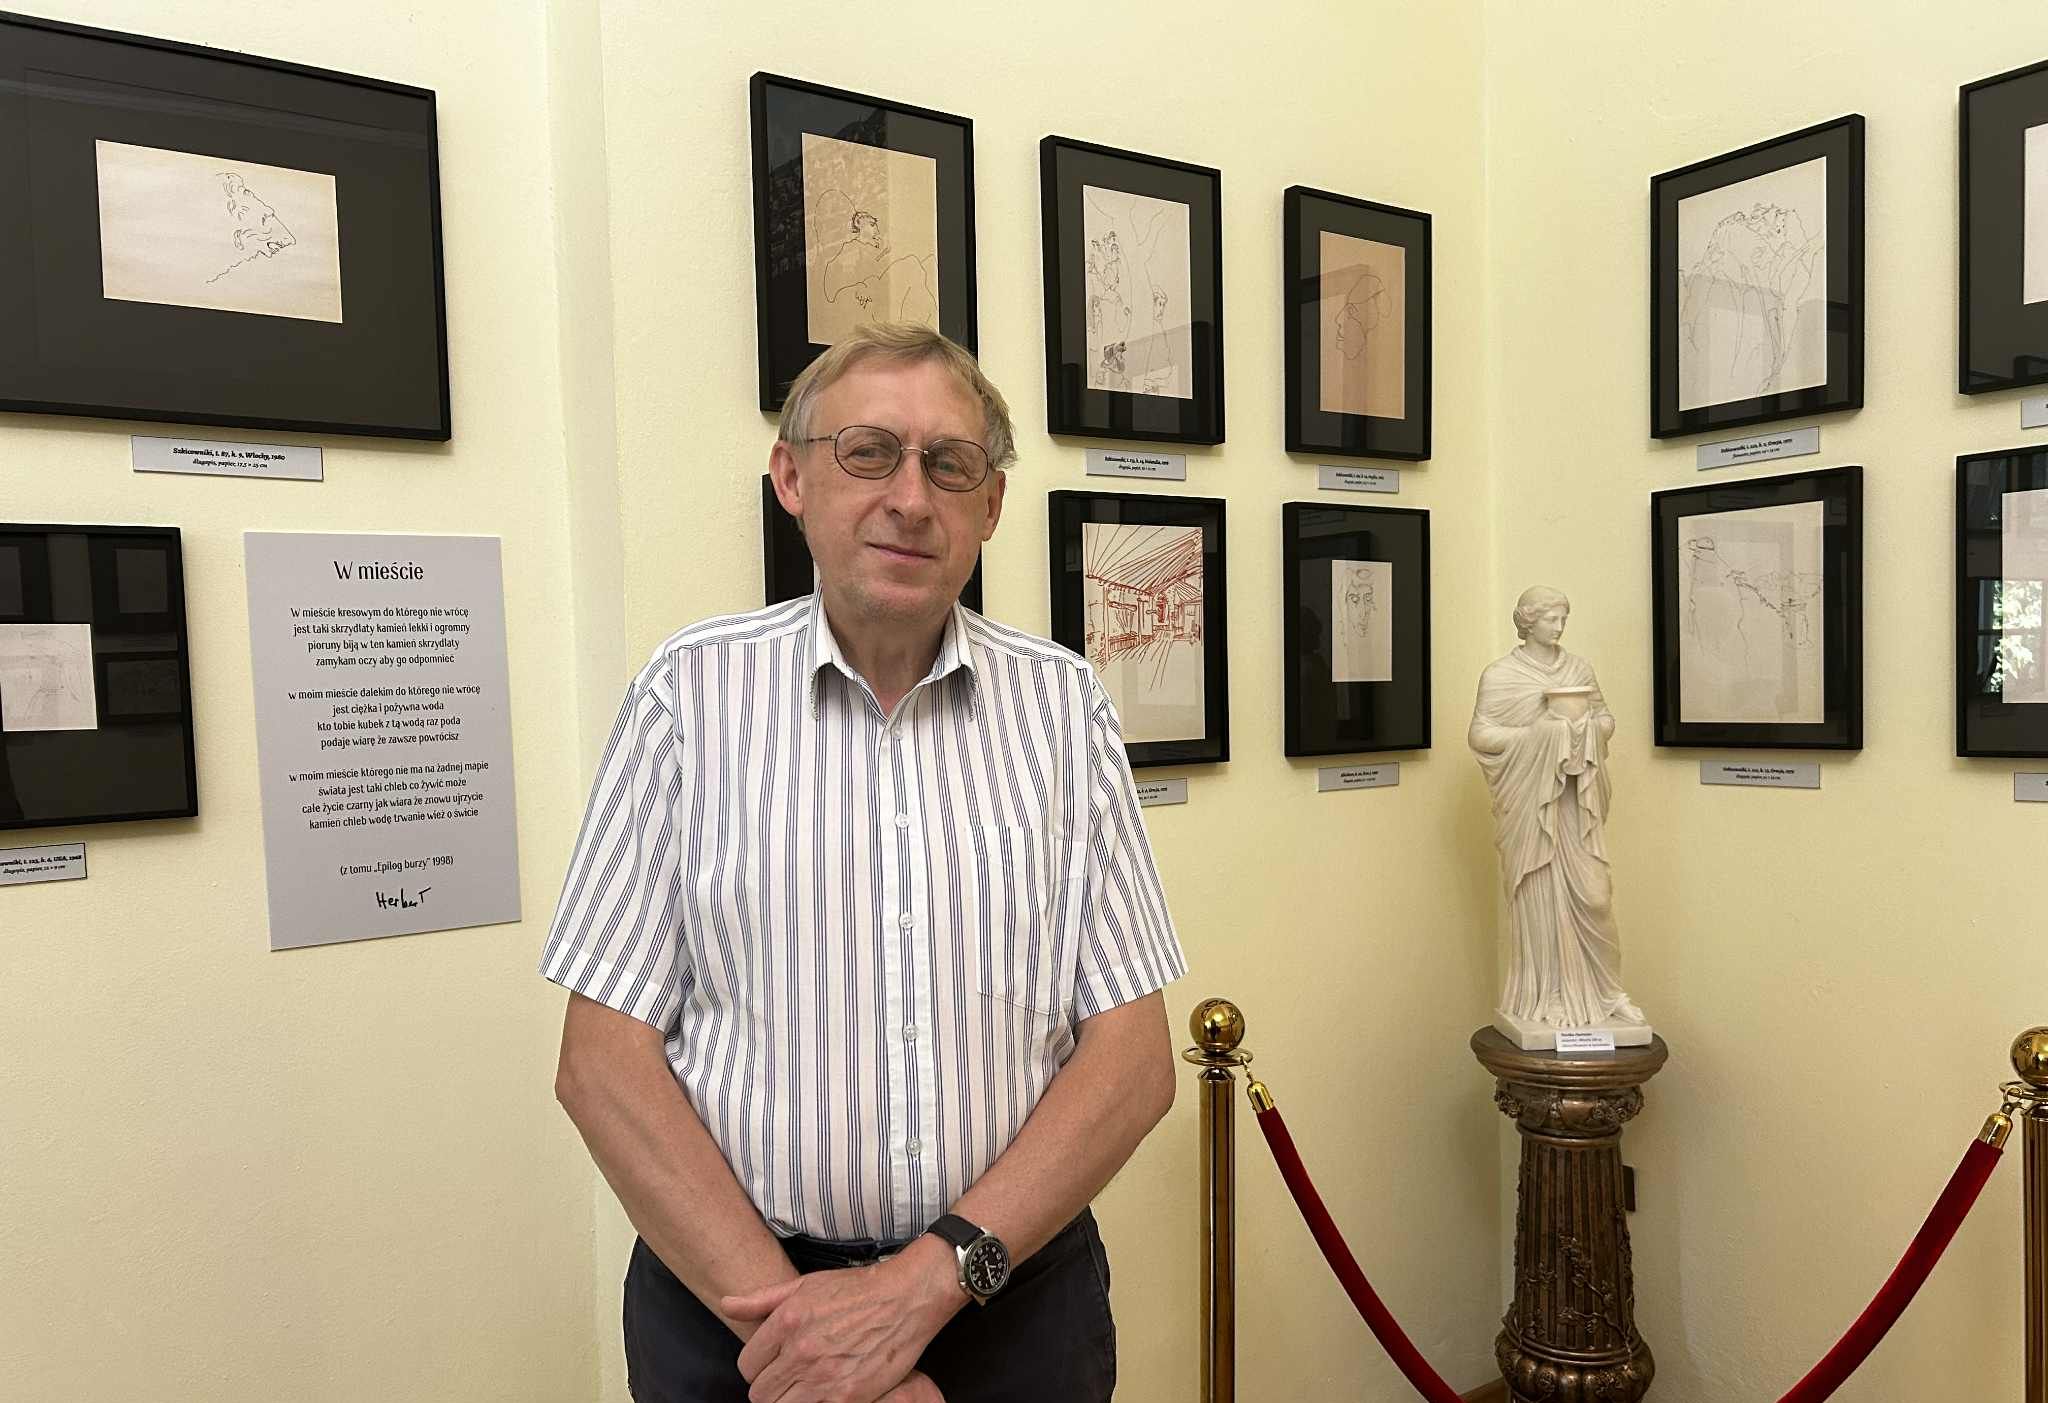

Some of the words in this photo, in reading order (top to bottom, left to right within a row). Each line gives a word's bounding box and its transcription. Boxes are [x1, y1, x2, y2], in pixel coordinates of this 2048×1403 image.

[334, 561, 353, 580] W
[359, 562, 424, 580] mieście
[291, 608, 300, 617] W
[303, 608, 336, 617] mieście
[338, 608, 381, 620] kresowym
[383, 608, 394, 616] do
[396, 608, 428, 619] którego
[430, 607, 443, 616] nie
[444, 608, 469, 618] wrócę
[293, 624, 311, 637] jest
[313, 624, 329, 633] taki
[377, 623, 407, 633] kamień
[409, 623, 429, 632] lekki
[430, 623, 433, 632] i
[434, 624, 471, 635] ogromny
[308, 640, 341, 653] pioruny
[343, 640, 359, 652] biją
[370, 640, 384, 649] ten
[316, 656, 356, 669] zamykam
[358, 657, 377, 668] oczy
[380, 655, 395, 667] aby
[396, 656, 407, 667] go
[288, 692, 296, 700] w
[298, 690, 323, 699] moim
[326, 688, 358, 698] mieście
[360, 687, 393, 697] dalekim
[396, 687, 406, 696] do
[408, 686, 440, 697] którego
[442, 685, 455, 694] nie
[332, 704, 349, 718] jest
[351, 704, 377, 715] ciężka
[384, 702, 420, 715] pożywna
[421, 701, 444, 711] woda
[317, 721, 332, 731] kto
[334, 721, 355, 730] tobie
[358, 719, 384, 729] kubek
[392, 720, 400, 729] tą
[401, 718, 425, 728] wodą
[440, 716, 461, 728] poda
[321, 737, 351, 750] podaje
[352, 736, 375, 747] wiarę
[377, 735, 386, 744] że
[388, 735, 417, 744] zawsze
[419, 732, 459, 745] powrócisz
[299, 771, 324, 781] moim
[326, 768, 359, 780] mieście
[361, 767, 394, 779] którego
[396, 765, 408, 775] nie
[410, 766, 423, 774] ma
[425, 765, 435, 773] na
[437, 762, 463, 774] żadnej
[465, 760, 489, 773] mapie
[319, 786, 346, 796] świata
[347, 784, 365, 797] jest
[367, 782, 382, 793] taki
[384, 781, 408, 792] chleb
[409, 782, 419, 790] co
[446, 777, 467, 787] może
[322, 802, 344, 815] życie
[346, 801, 374, 812] czarny
[375, 798, 389, 812] jak
[390, 797, 412, 807] wiara
[414, 796, 423, 805] że
[424, 795, 451, 805] znowu
[453, 792, 484, 805] ujrzycie
[343, 815, 367, 827] chleb
[368, 814, 392, 824] wodę
[394, 812, 425, 823] trwanie
[447, 811, 452, 819] o
[340, 865, 347, 876] (z
[349, 865, 372, 874] tomu
[433, 855, 454, 866] 1998)
